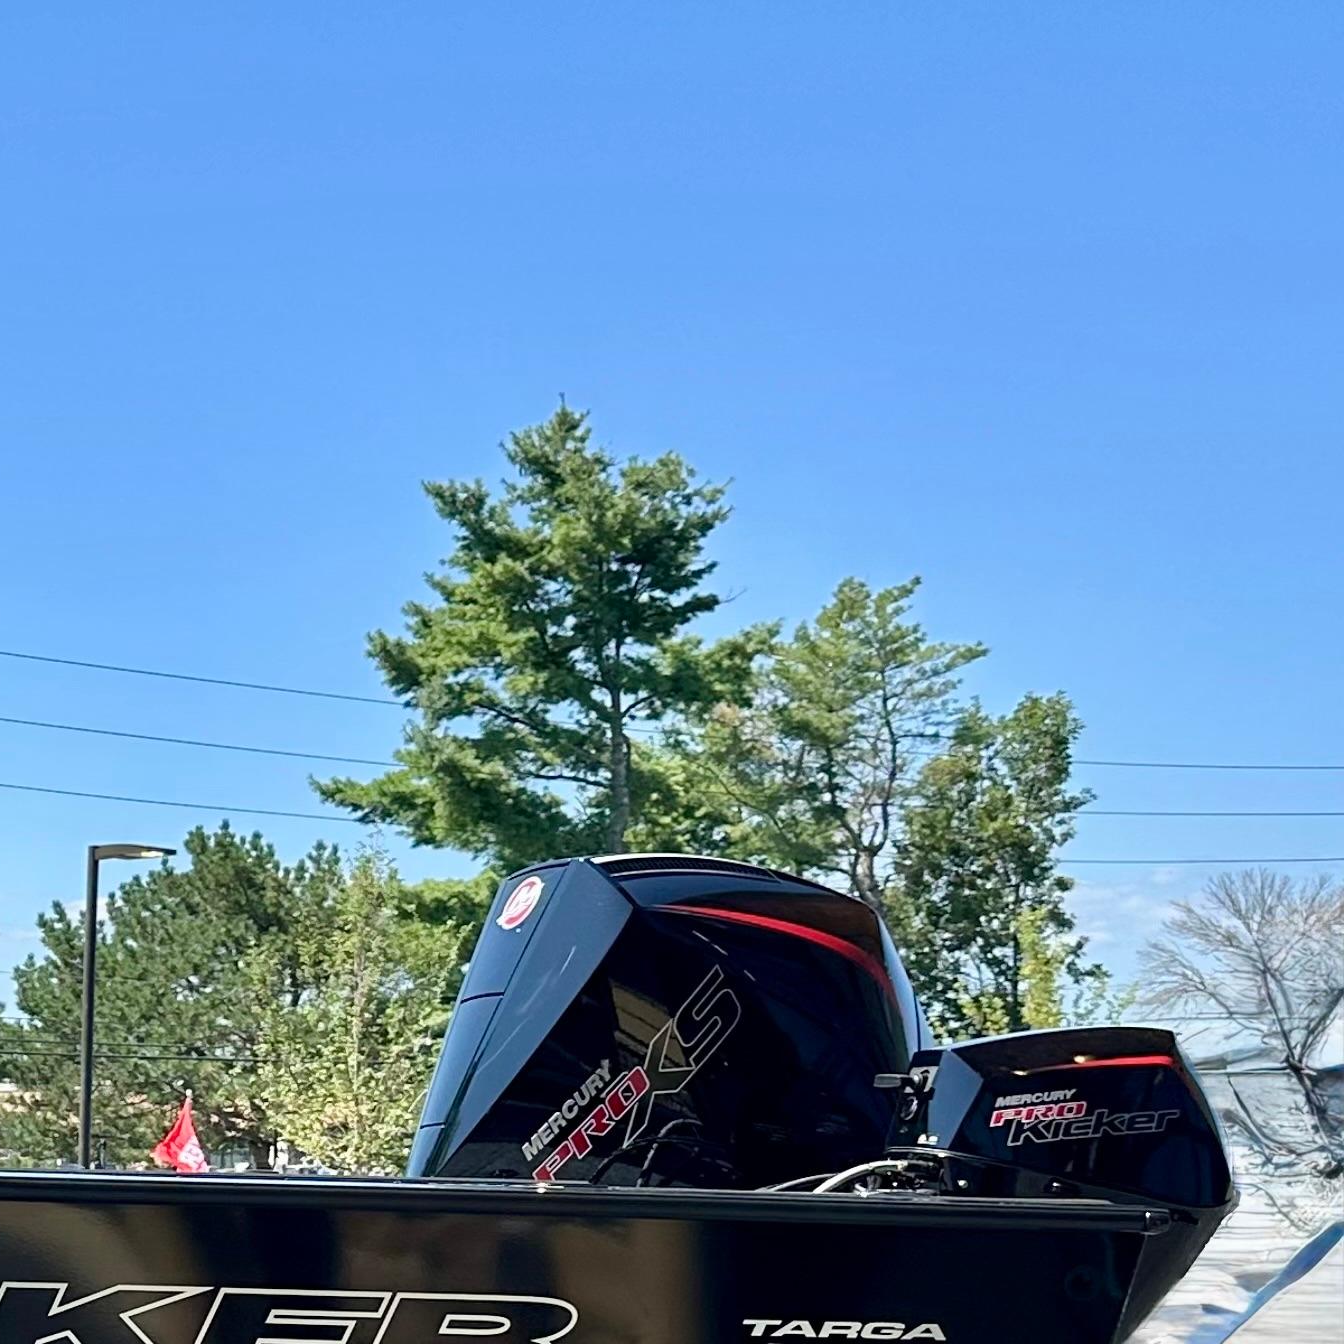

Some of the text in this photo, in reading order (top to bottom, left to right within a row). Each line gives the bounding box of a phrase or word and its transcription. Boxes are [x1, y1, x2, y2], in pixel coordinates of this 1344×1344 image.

[521, 1059, 613, 1162] MERCURY
[995, 1088, 1077, 1108] MERCURY
[532, 1065, 650, 1182] PRO
[990, 1101, 1087, 1128] PRO
[742, 1318, 947, 1342] TARGA
